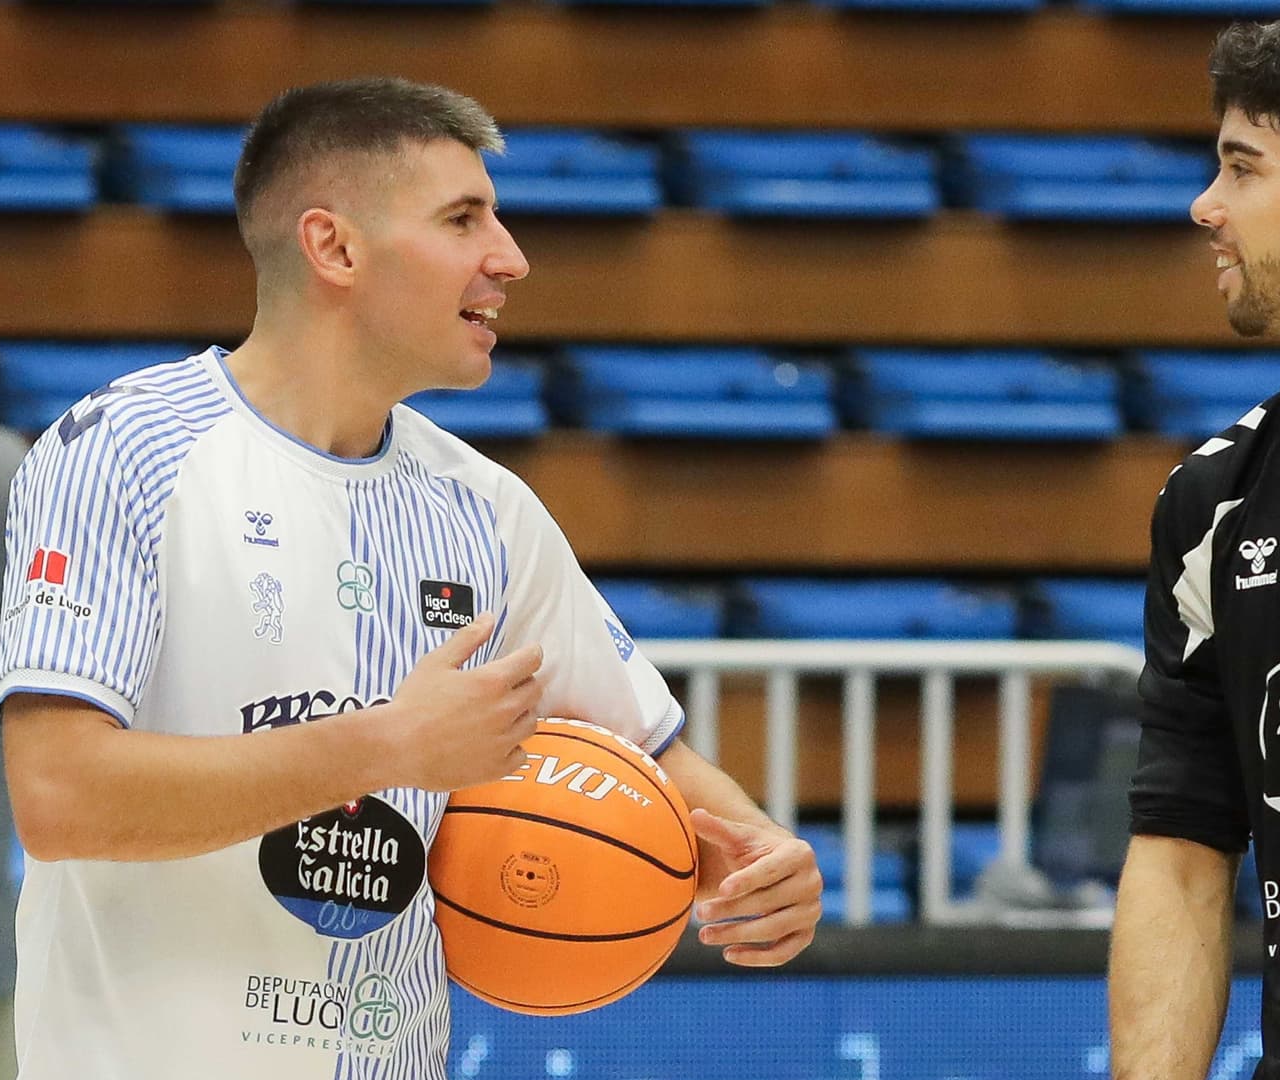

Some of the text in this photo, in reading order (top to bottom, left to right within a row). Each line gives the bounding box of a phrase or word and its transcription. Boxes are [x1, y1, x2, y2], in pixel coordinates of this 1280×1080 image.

[1235, 569, 1278, 590] humme
[35, 591, 54, 605] de
[59, 595, 91, 617] Lugo
[425, 593, 450, 609] liga
[617, 783, 653, 807] NXT
[297, 853, 389, 903] Galicia
[245, 993, 270, 1009] DE
